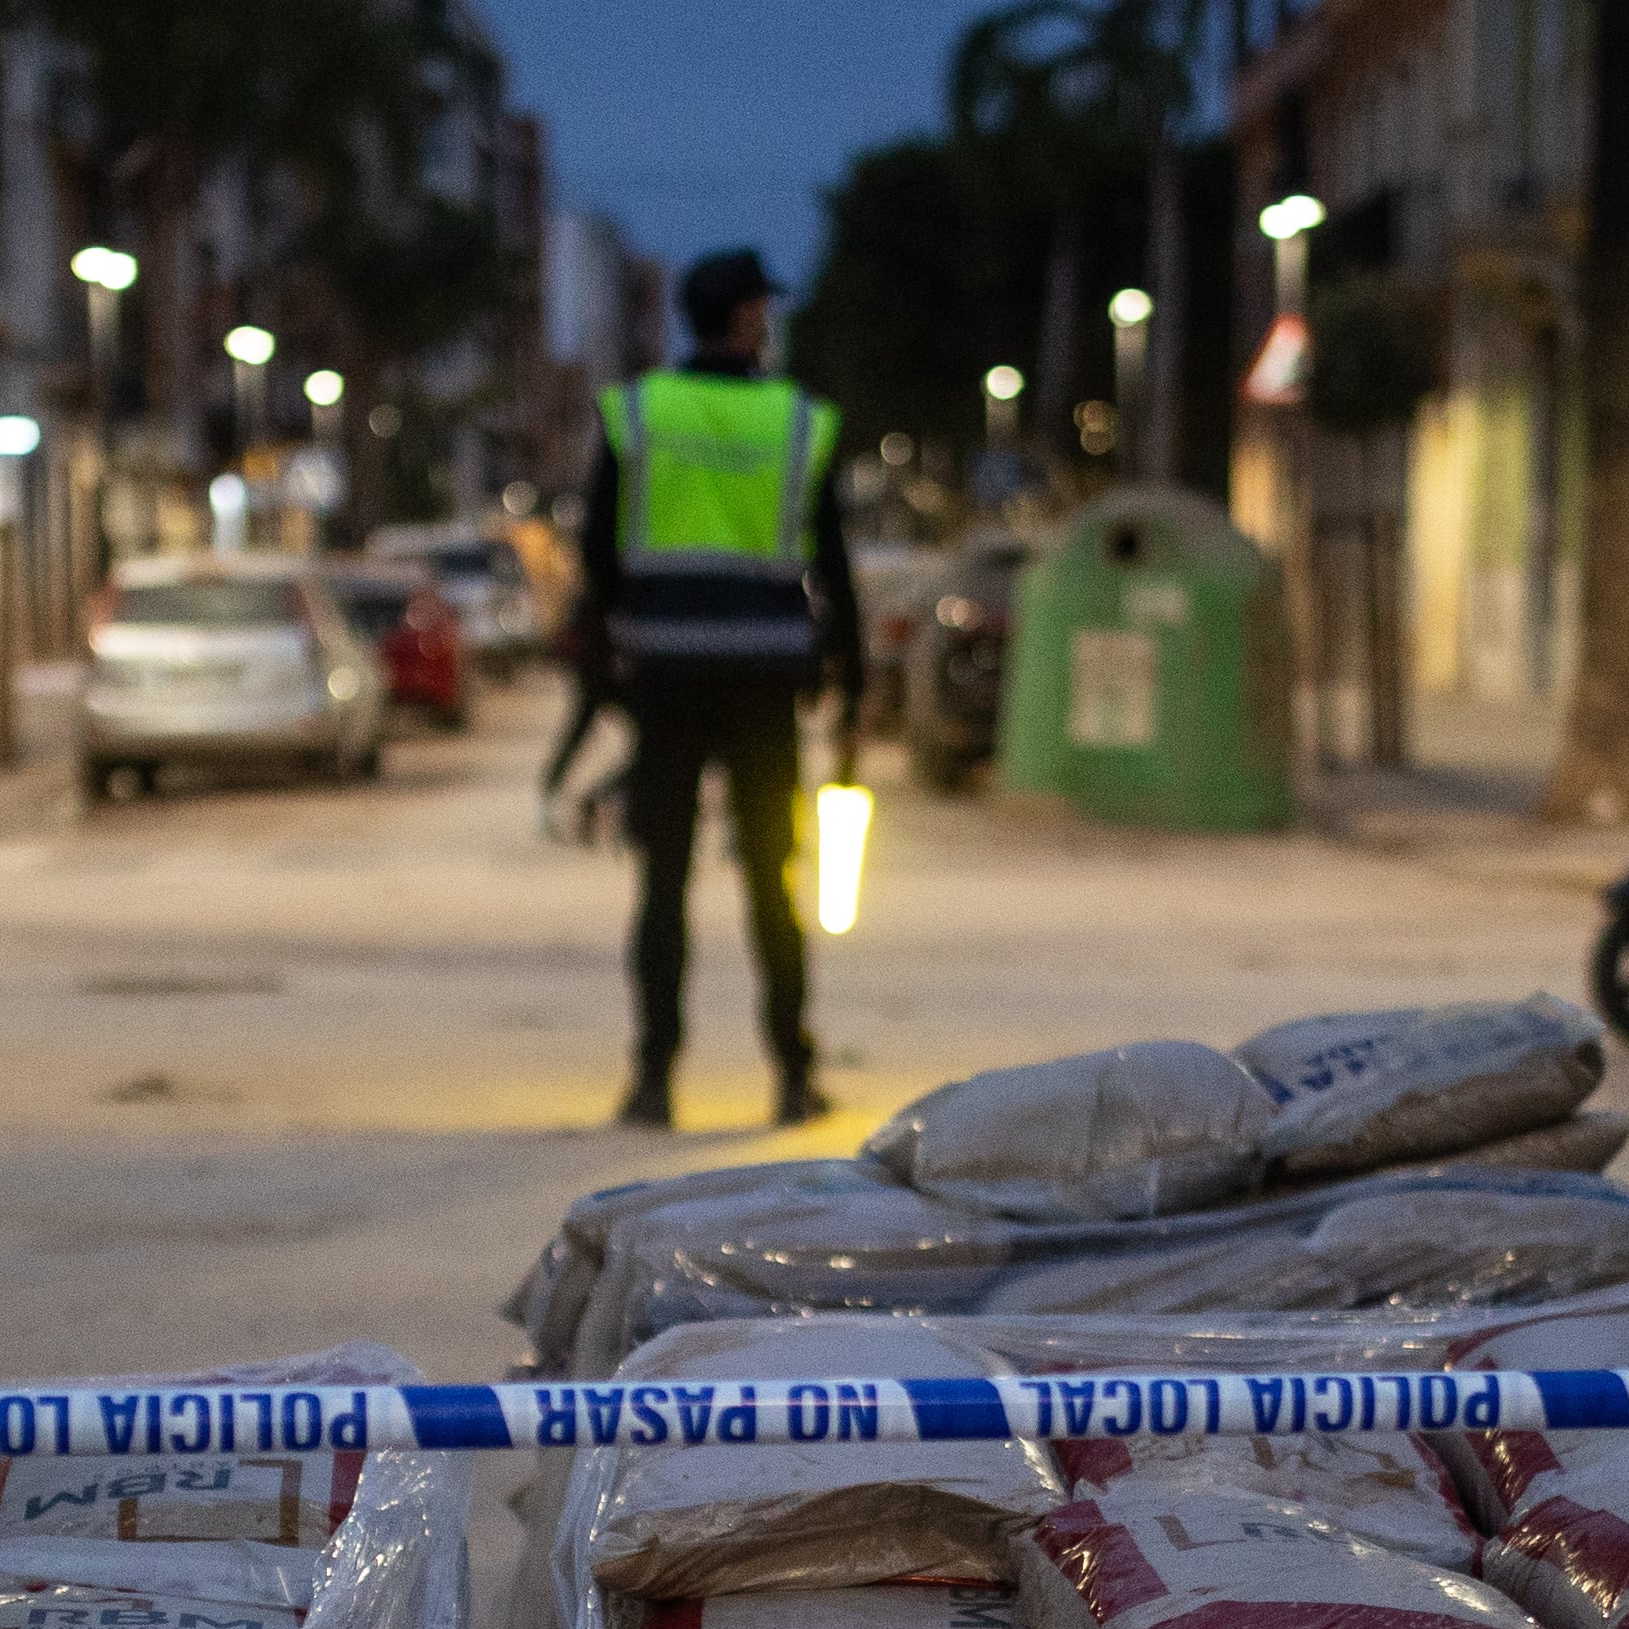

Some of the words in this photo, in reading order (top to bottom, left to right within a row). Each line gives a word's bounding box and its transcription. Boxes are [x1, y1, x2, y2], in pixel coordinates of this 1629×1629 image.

[98, 1391, 370, 1455] POLICIA
[535, 1384, 756, 1446] PASAR
[788, 1382, 879, 1442] NO
[1022, 1377, 1220, 1438] LOCAL
[1247, 1373, 1500, 1432] POLICIA
[25, 1469, 232, 1520] RBM
[949, 1587, 1014, 1629] BM
